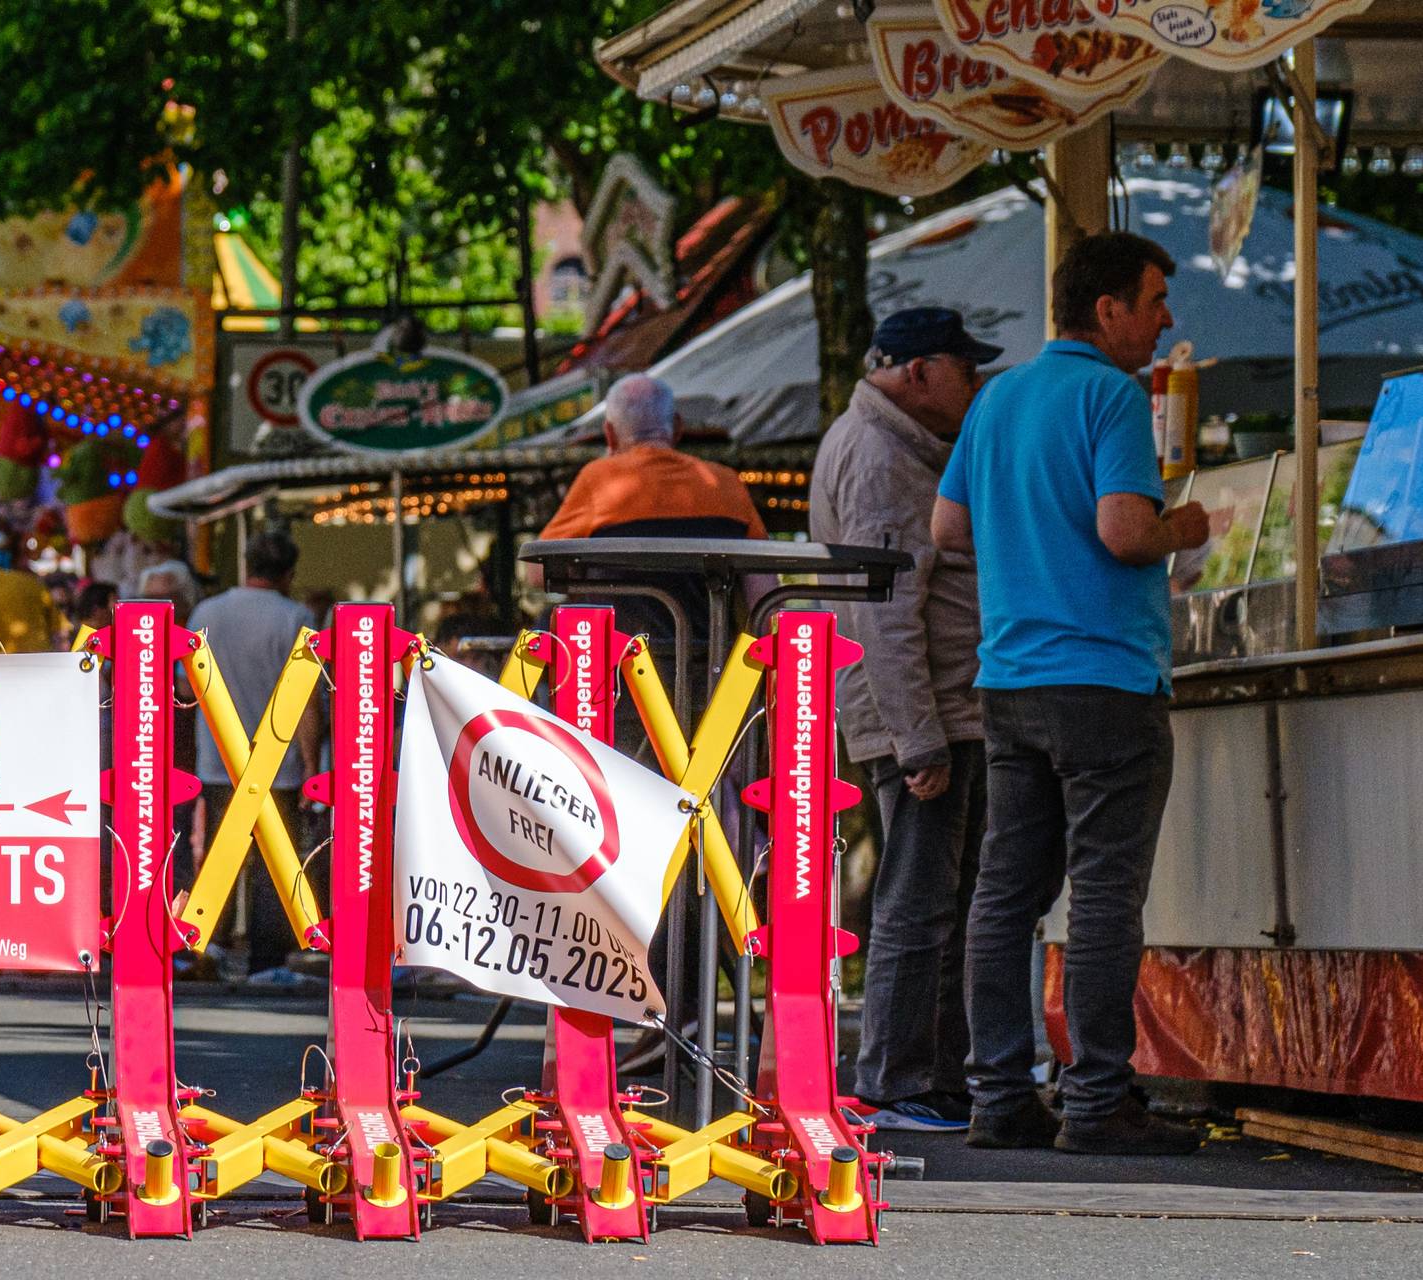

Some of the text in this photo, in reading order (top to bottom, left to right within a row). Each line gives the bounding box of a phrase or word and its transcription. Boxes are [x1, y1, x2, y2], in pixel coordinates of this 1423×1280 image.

[132, 615, 159, 890] www.zufahrtssperre.de
[352, 617, 379, 892] www.zufahrtssperre.de
[478, 750, 596, 829] ANLIEGER
[789, 624, 817, 898] www.zufahrtssperre.de
[509, 807, 554, 856] FREI
[405, 903, 647, 1002] 06.-12.05.2025
[409, 876, 447, 906] von
[453, 882, 601, 947] 22.30-11.00
